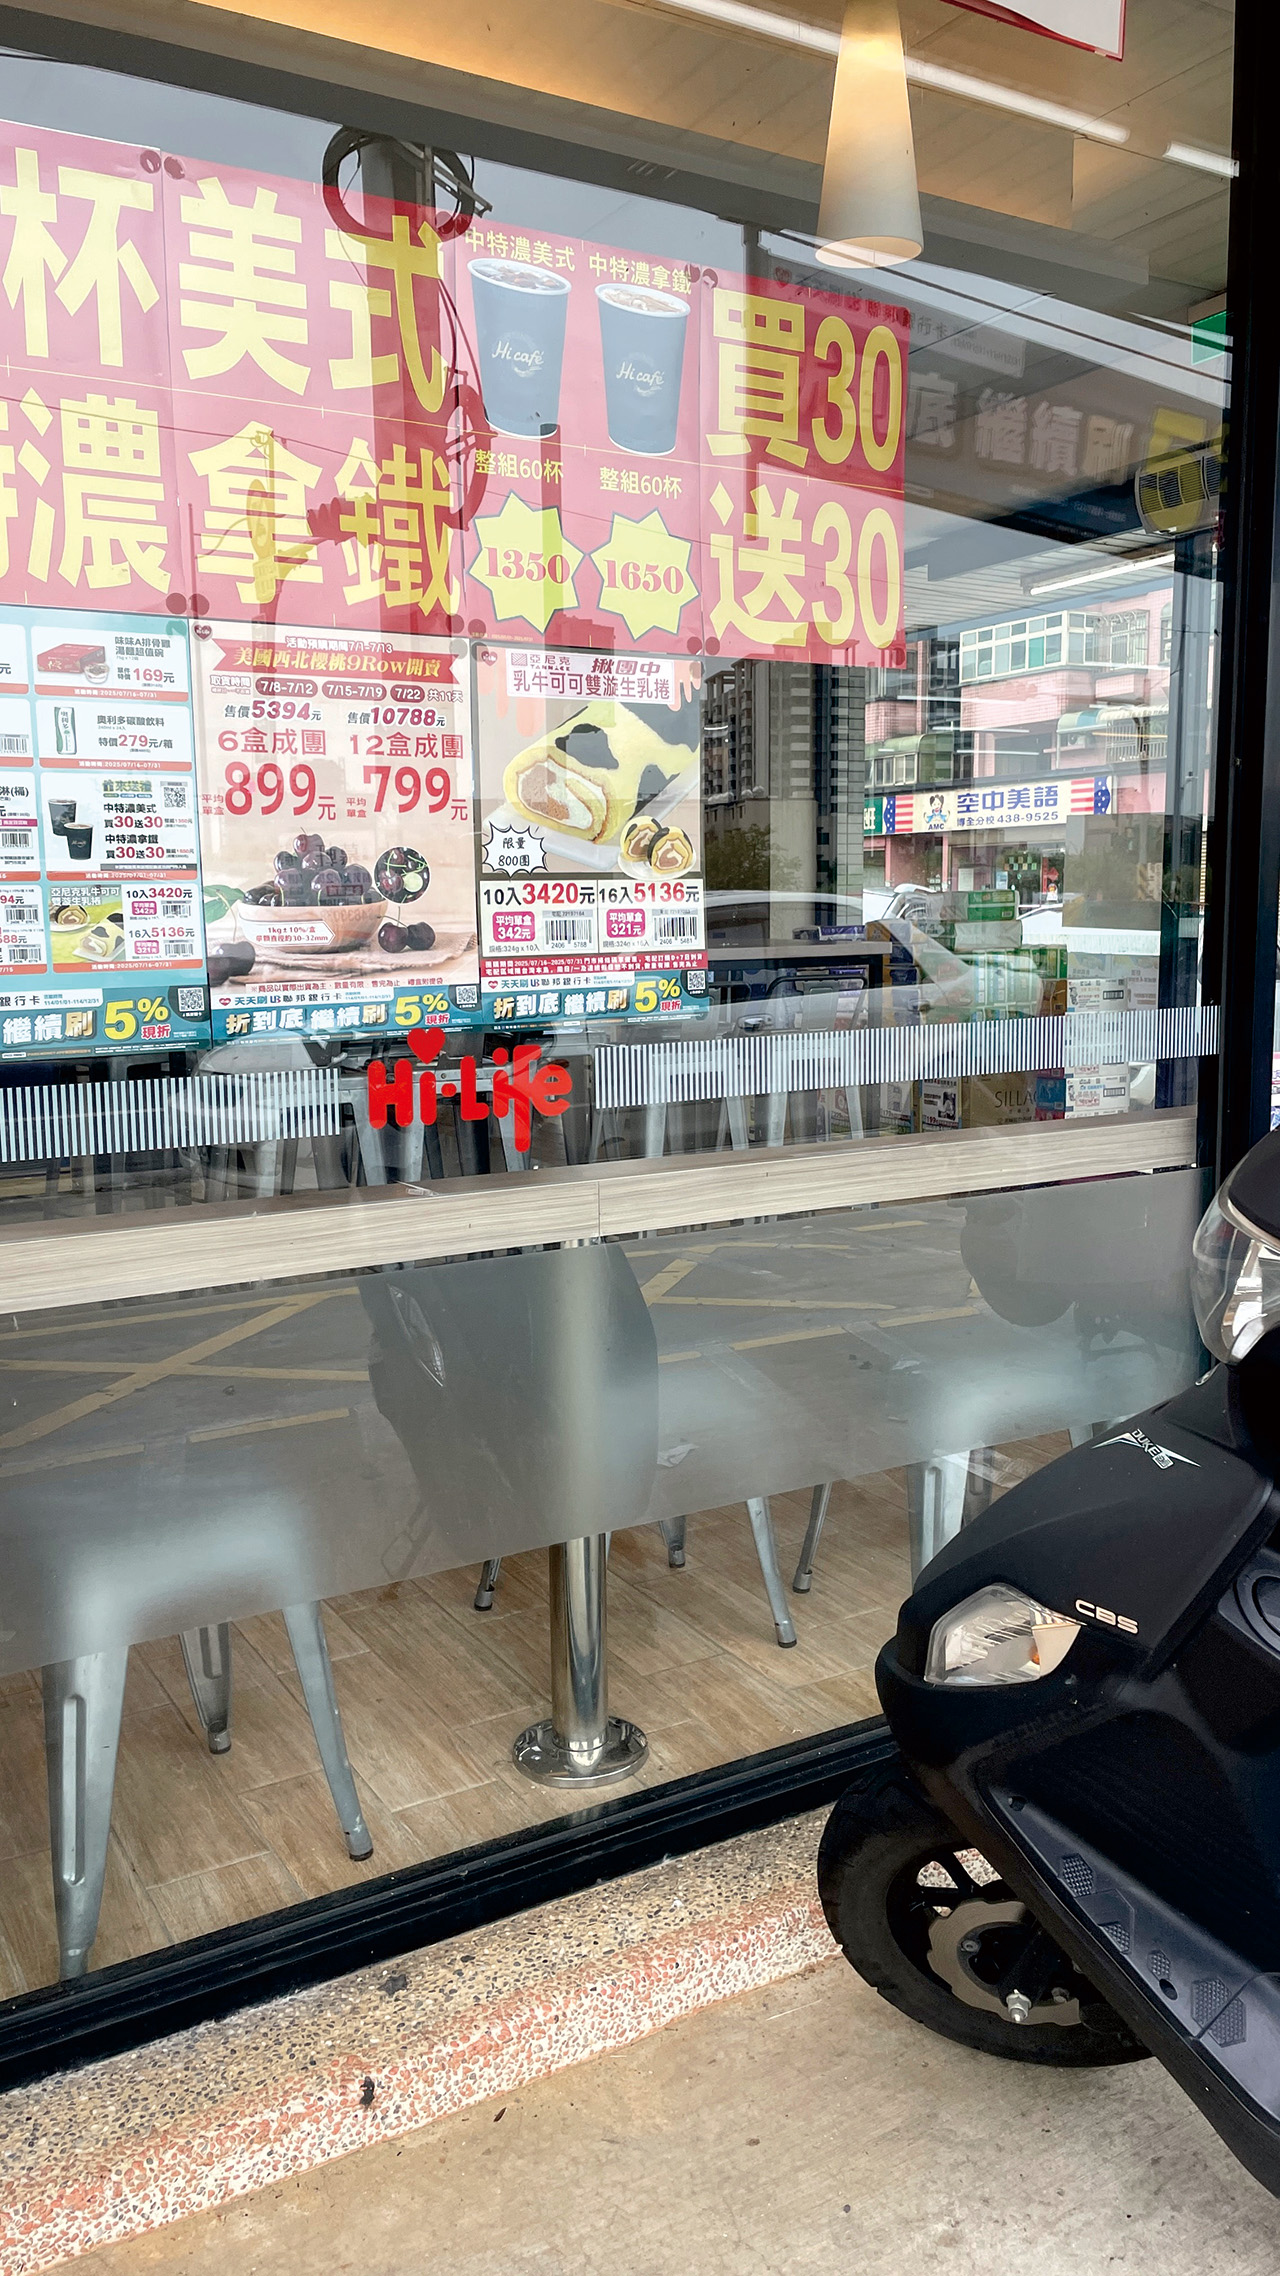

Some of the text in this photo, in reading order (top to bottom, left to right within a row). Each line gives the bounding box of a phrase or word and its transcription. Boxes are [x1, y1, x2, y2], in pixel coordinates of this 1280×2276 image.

[465, 229, 576, 272] 中特濃美式
[588, 252, 692, 295] 中特濃拿鐵
[706, 288, 901, 471] 買30
[475, 449, 564, 485] 整組60杯
[600, 466, 683, 500] 整組60杯
[485, 547, 571, 585] 1350
[604, 558, 684, 595] 1650
[709, 480, 900, 649] 送30
[133, 667, 175, 684] 169元
[591, 658, 661, 677] 揪團中
[224, 699, 322, 722] 售價5394元
[347, 706, 446, 727] 售價10788元
[217, 726, 327, 756] 6盒成團
[351, 731, 464, 759] 12盒成團
[103, 803, 158, 814] 中特濃美式
[201, 794, 225, 804] 平均
[346, 797, 367, 807] 平均
[957, 785, 1059, 814] 空中美語
[928, 823, 945, 831] AMC
[997, 811, 1059, 824] 438-9525
[502, 837, 526, 850] 限量
[126, 887, 193, 899] 10入3420元
[483, 882, 596, 906] 10入3420元
[599, 881, 700, 905] 16入5136元
[495, 914, 532, 926] 平均單盒
[609, 911, 643, 923] 平均單盒
[128, 926, 195, 939] 16入5136元
[497, 926, 531, 940] 342元
[611, 923, 642, 936] 321元
[494, 988, 628, 1019] 折到底 繼續刷
[635, 978, 681, 1013] 5%
[660, 1000, 682, 1012] 現折
[104, 996, 169, 1041] 5%
[226, 1003, 387, 1036] 折到底 繼續刷
[395, 993, 449, 1027] 5%
[424, 1013, 449, 1026] 現折
[2, 1010, 96, 1046] 繼續刷
[141, 1024, 171, 1040] 現折
[1131, 1428, 1161, 1457] DUKE
[1075, 1599, 1140, 1635] CBS
